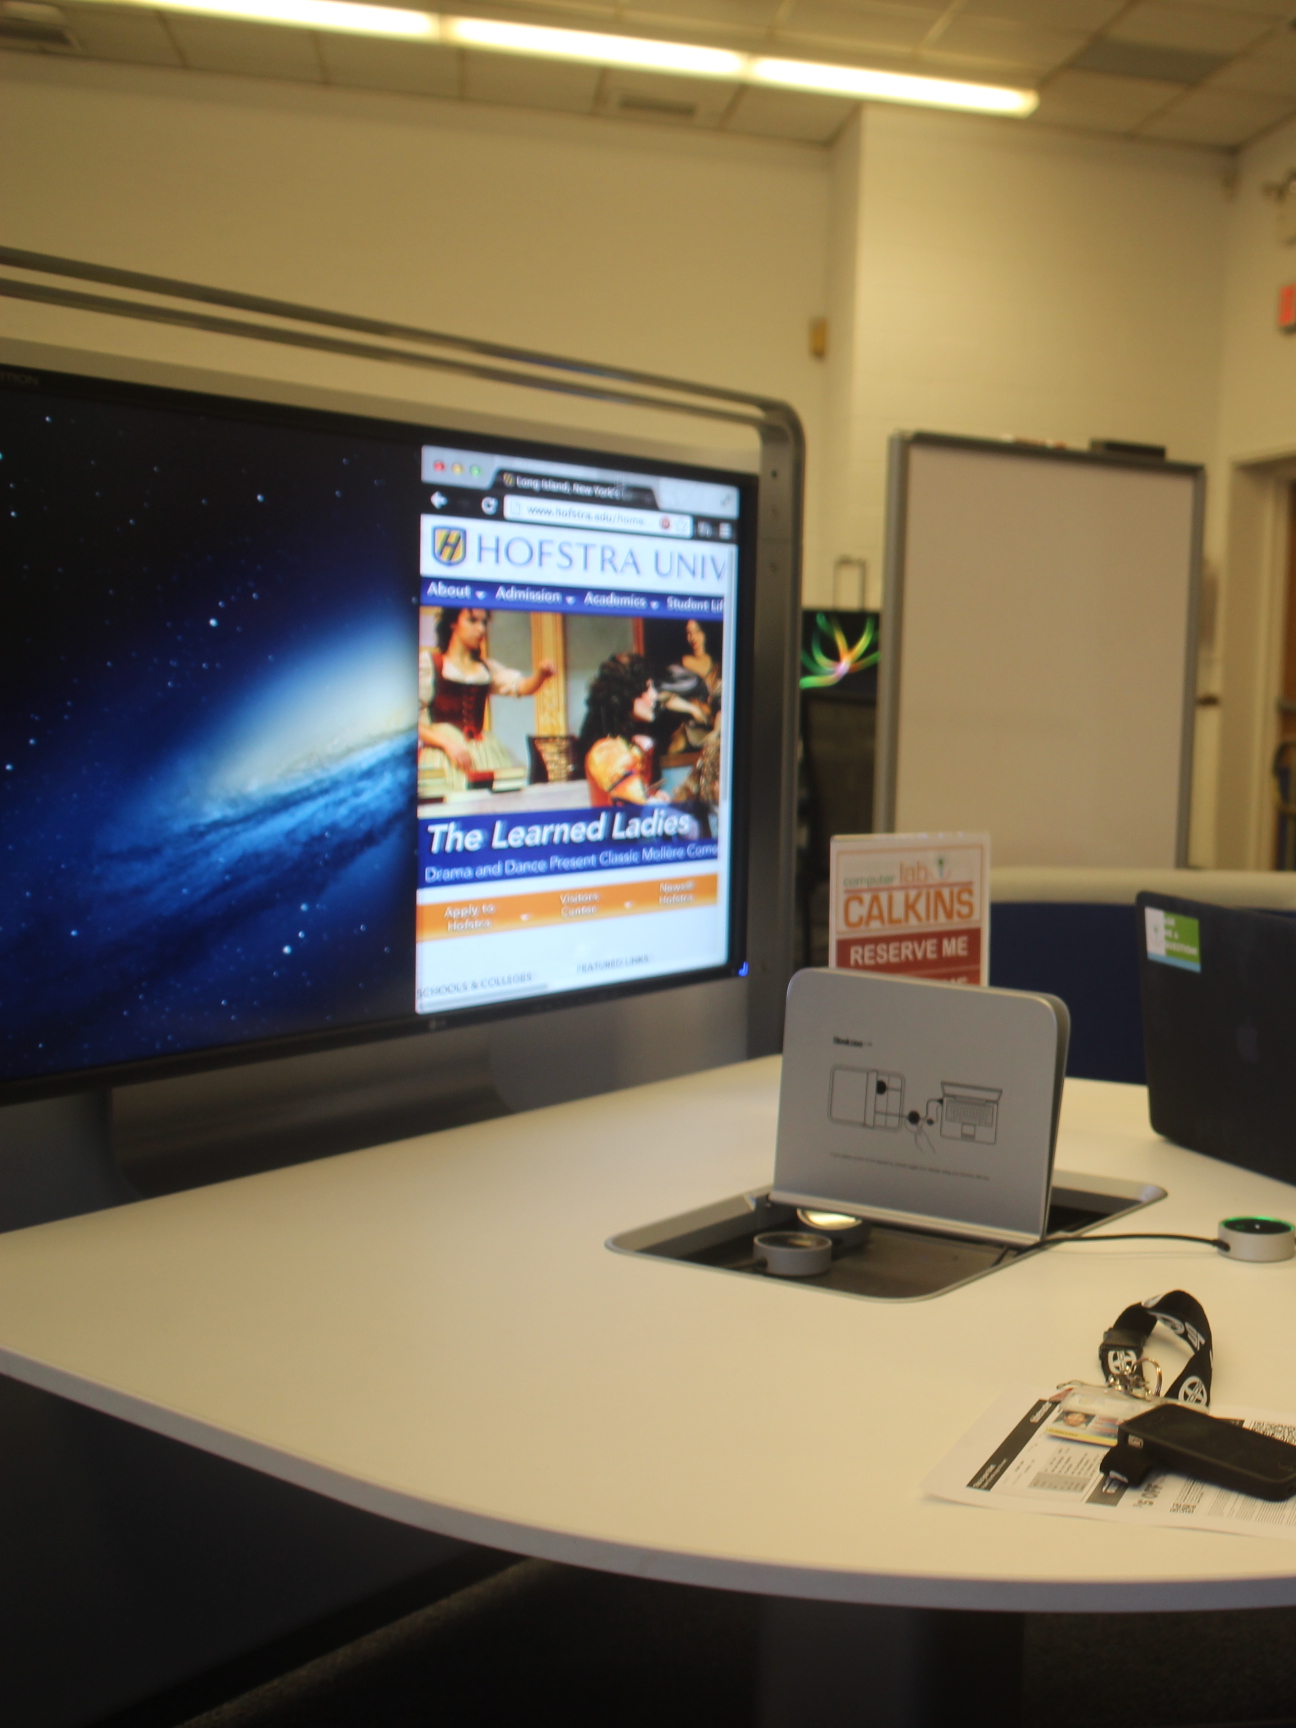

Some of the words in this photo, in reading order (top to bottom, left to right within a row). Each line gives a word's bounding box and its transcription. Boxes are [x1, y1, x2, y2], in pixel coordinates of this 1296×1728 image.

[516, 476, 539, 492] Long
[477, 533, 641, 577] HOFSTRA
[653, 552, 727, 580] UNIV
[427, 581, 471, 599] About
[495, 586, 560, 604] Admission
[584, 592, 646, 609] Academics
[667, 596, 709, 612] Student
[427, 820, 484, 854] The
[491, 812, 605, 849] Learned
[611, 808, 690, 840] Ladies
[425, 866, 471, 883] Drama
[475, 862, 501, 878] and
[504, 857, 546, 874] Dance
[549, 852, 598, 870] Present
[599, 848, 639, 865] Classic
[900, 861, 928, 885] lab
[560, 892, 600, 905] Visitors
[843, 887, 975, 928] CALKINS
[444, 906, 479, 920] Apply
[482, 903, 496, 914] to
[447, 919, 493, 932] Hofstra
[851, 938, 937, 967] RESERVE
[942, 936, 968, 958] ME
[417, 981, 468, 999] SCHOOLS
[480, 973, 533, 989] COLLEGES
